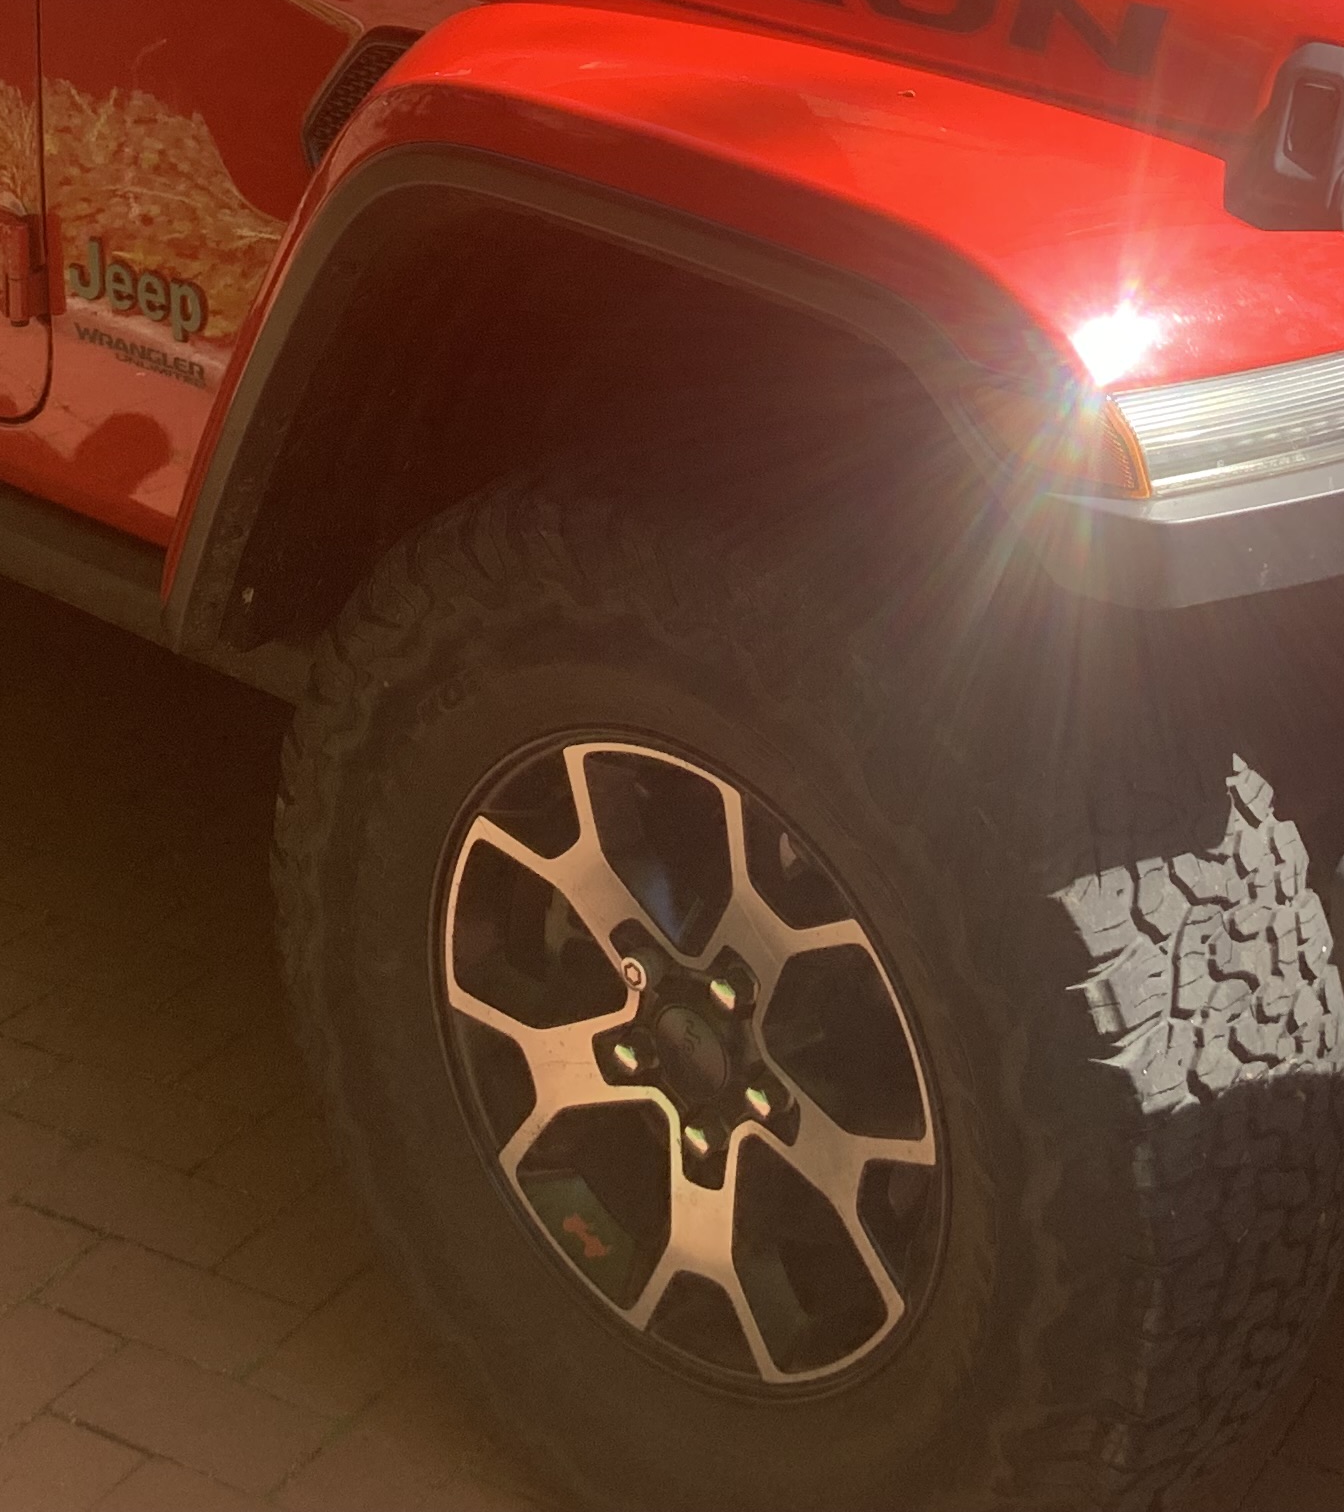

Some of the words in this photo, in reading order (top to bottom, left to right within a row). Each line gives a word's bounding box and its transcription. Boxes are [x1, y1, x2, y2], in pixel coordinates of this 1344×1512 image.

[68, 236, 208, 342] Jeep
[73, 322, 205, 380] WRANGLER
[115, 353, 207, 389] UNLIMITED
